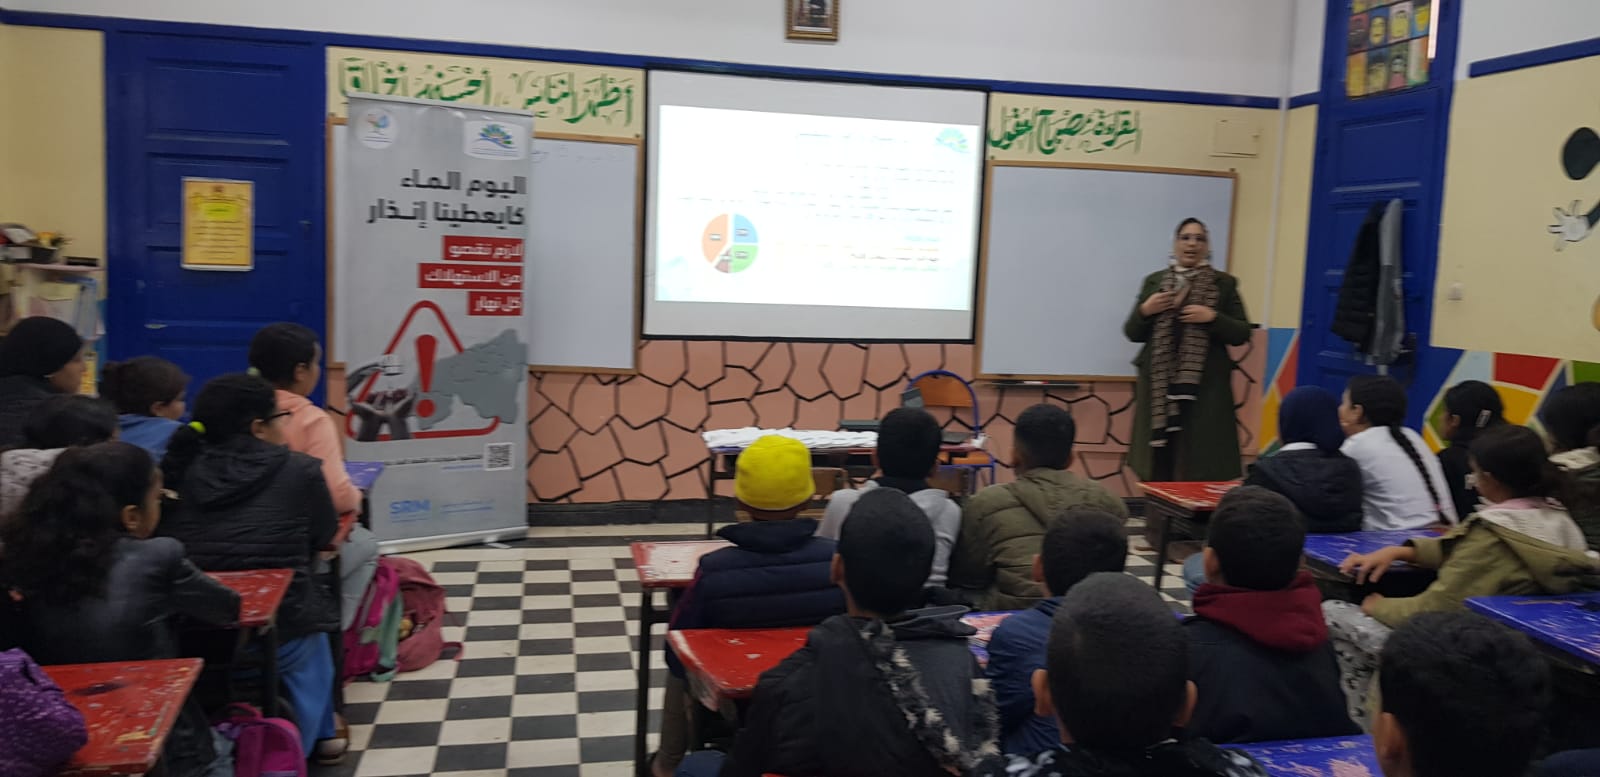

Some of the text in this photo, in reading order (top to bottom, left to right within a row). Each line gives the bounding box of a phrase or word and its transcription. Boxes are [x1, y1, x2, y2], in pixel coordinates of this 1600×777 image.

[400, 168, 527, 198] اليوم الماء
[366, 198, 525, 230] كايعطينا إنذار
[448, 243, 523, 259] لازم نقصو
[424, 268, 521, 286] من الاستهلاك
[474, 296, 521, 312] كل نهار
